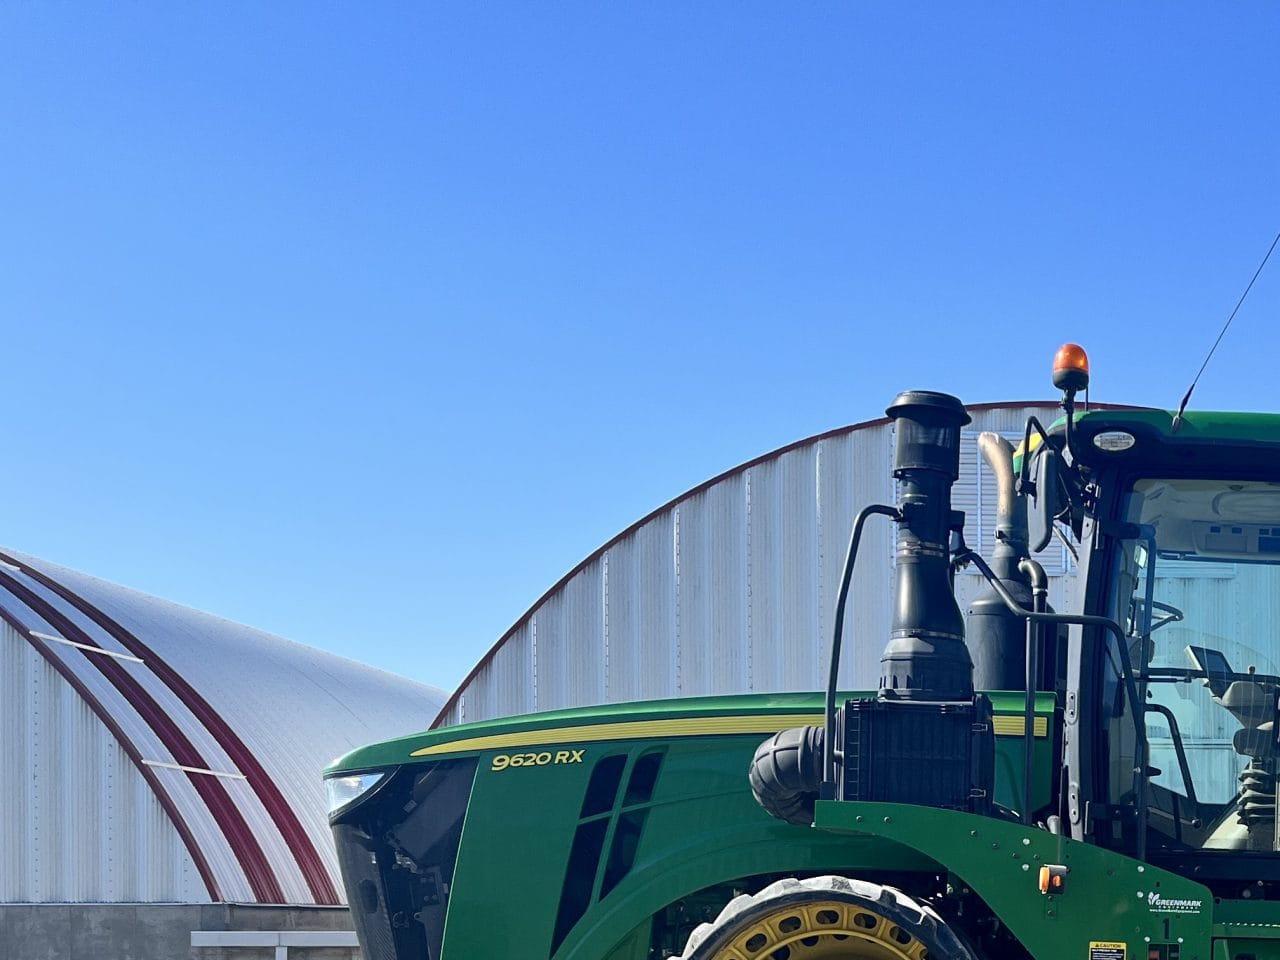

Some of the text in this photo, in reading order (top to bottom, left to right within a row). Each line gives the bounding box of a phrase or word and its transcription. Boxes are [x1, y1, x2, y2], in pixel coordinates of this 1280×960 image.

[491, 749, 586, 771] 9620 RX
[1155, 899, 1202, 907] GREENMARK
